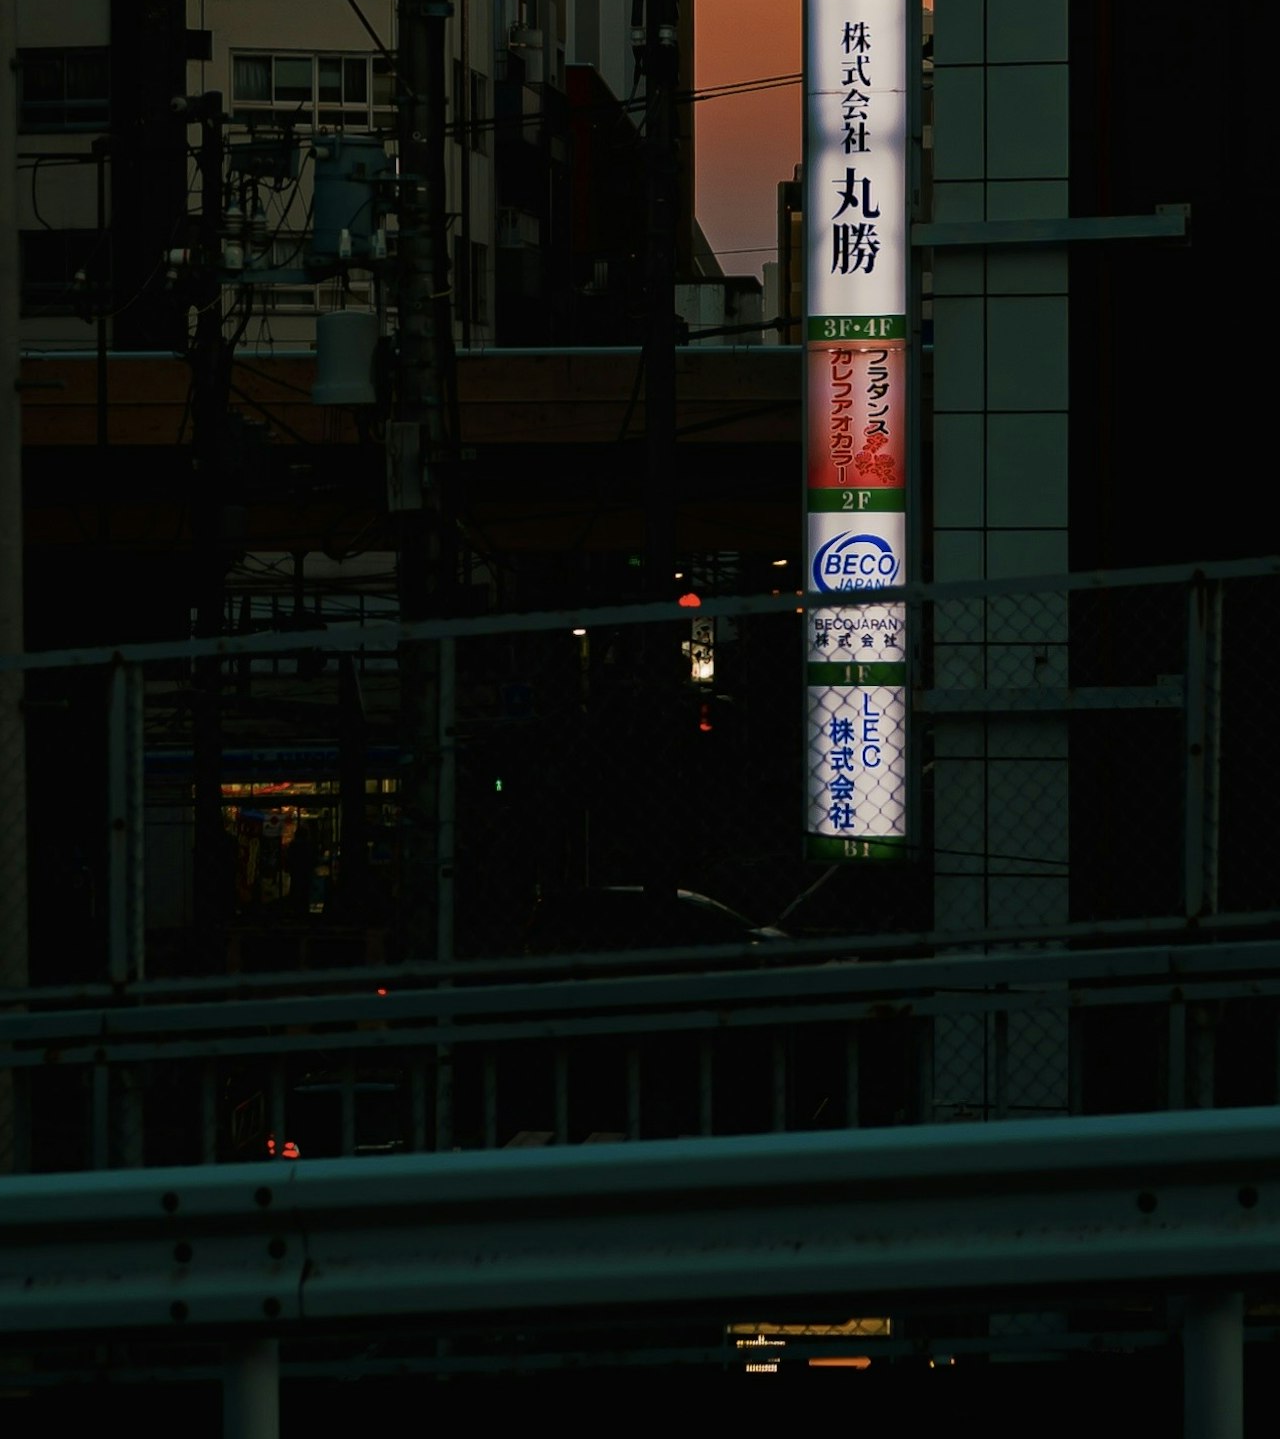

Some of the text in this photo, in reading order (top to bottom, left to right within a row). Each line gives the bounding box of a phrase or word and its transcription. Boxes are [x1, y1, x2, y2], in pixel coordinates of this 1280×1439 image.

[831, 21, 881, 275] 株式会社 丸勝
[867, 349, 890, 435] フラダンス
[842, 491, 871, 510] 2F
[824, 553, 896, 575] BECO
[816, 633, 898, 648] 株式会社
[862, 693, 881, 768] LEC
[829, 717, 855, 829] 株式会社
